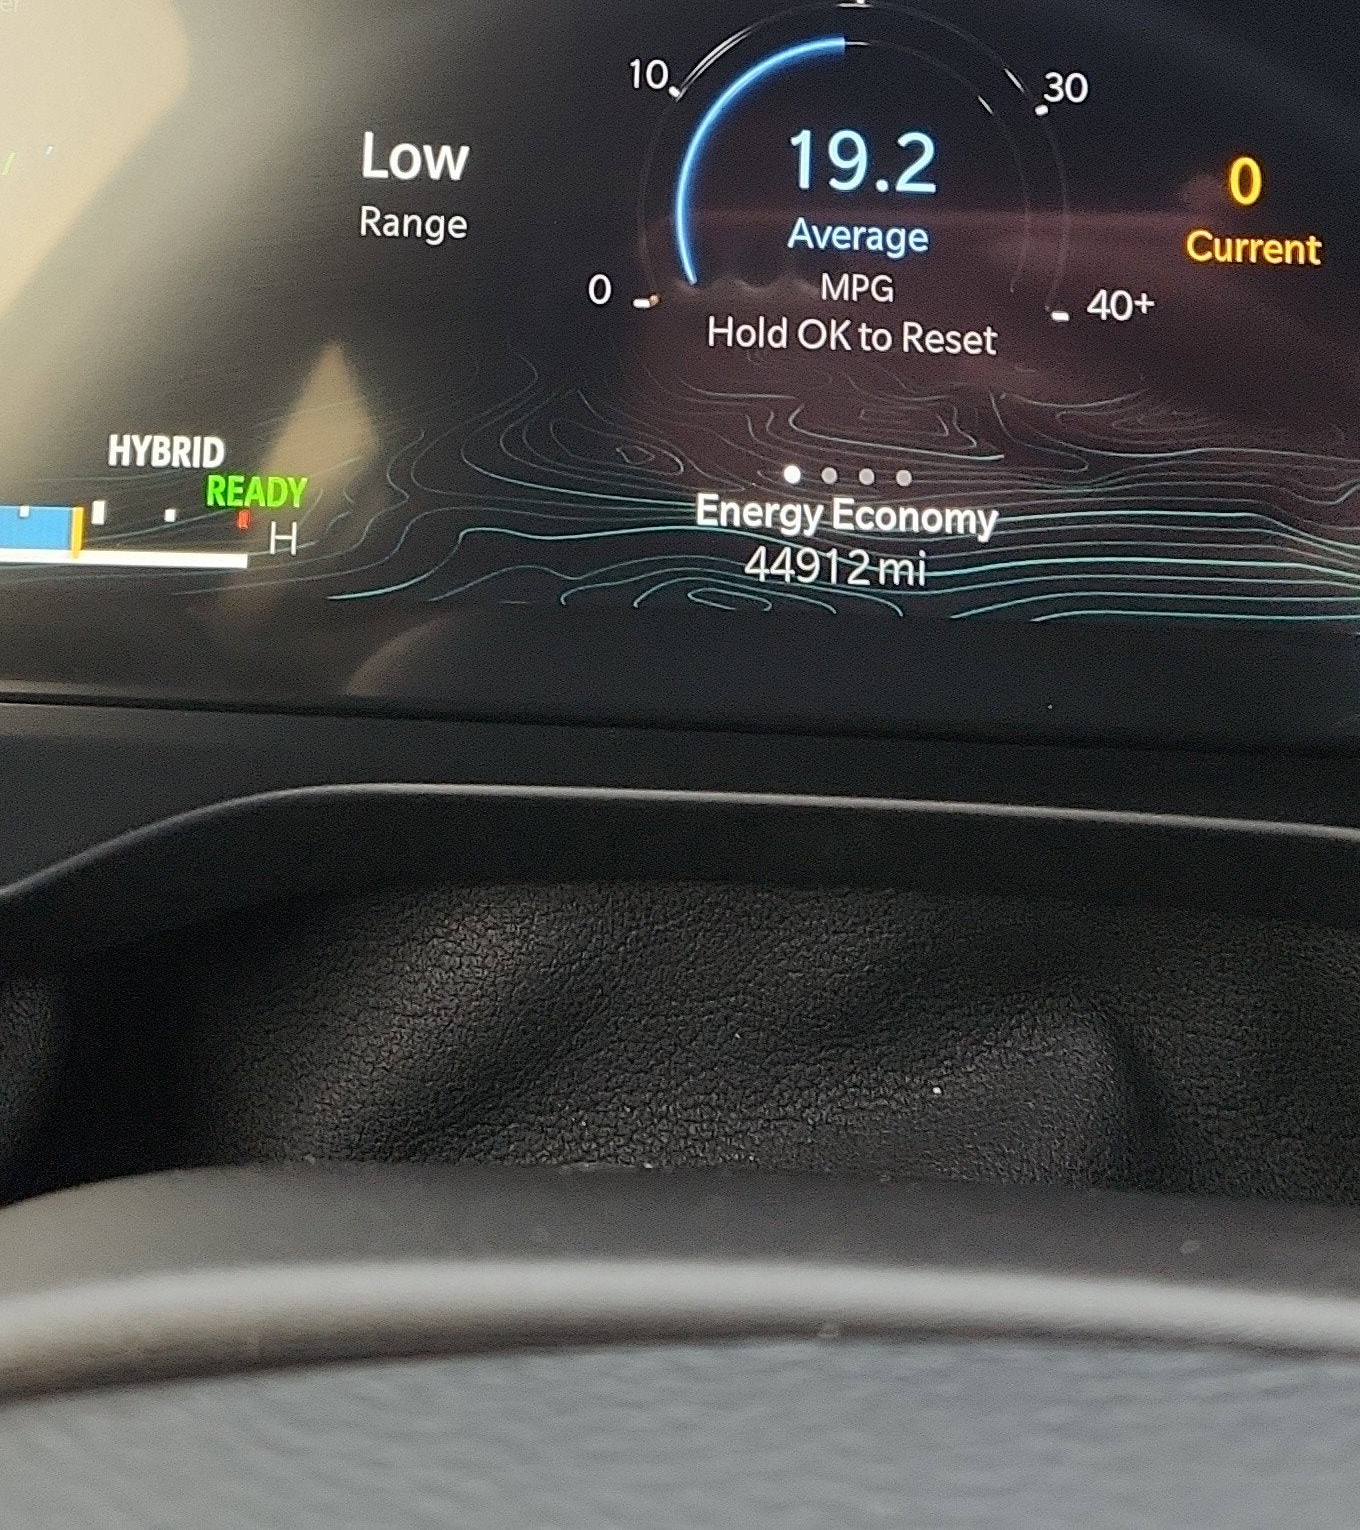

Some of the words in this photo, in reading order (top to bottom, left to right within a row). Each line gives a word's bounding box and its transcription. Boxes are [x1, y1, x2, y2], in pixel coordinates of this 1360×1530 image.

[630, 58, 669, 90] 10
[1043, 71, 1089, 103] 30
[362, 130, 470, 181] Low
[790, 129, 937, 194] 19.2
[1228, 156, 1262, 206] 0
[360, 205, 468, 246] Range
[787, 216, 929, 259] Average
[1186, 228, 1323, 266] Current
[588, 273, 612, 305] 0
[821, 272, 894, 303] MPG
[1086, 288, 1155, 321] 40+
[708, 315, 788, 349] Hold
[797, 318, 852, 351] OK
[857, 322, 893, 352] to
[902, 321, 999, 356] Reset
[108, 433, 225, 469] HYBRID
[206, 474, 308, 509] READY
[695, 492, 824, 536] Energy
[832, 496, 999, 543] Economy
[268, 520, 299, 557] H
[744, 545, 871, 586] 44912
[877, 549, 927, 587] mi
